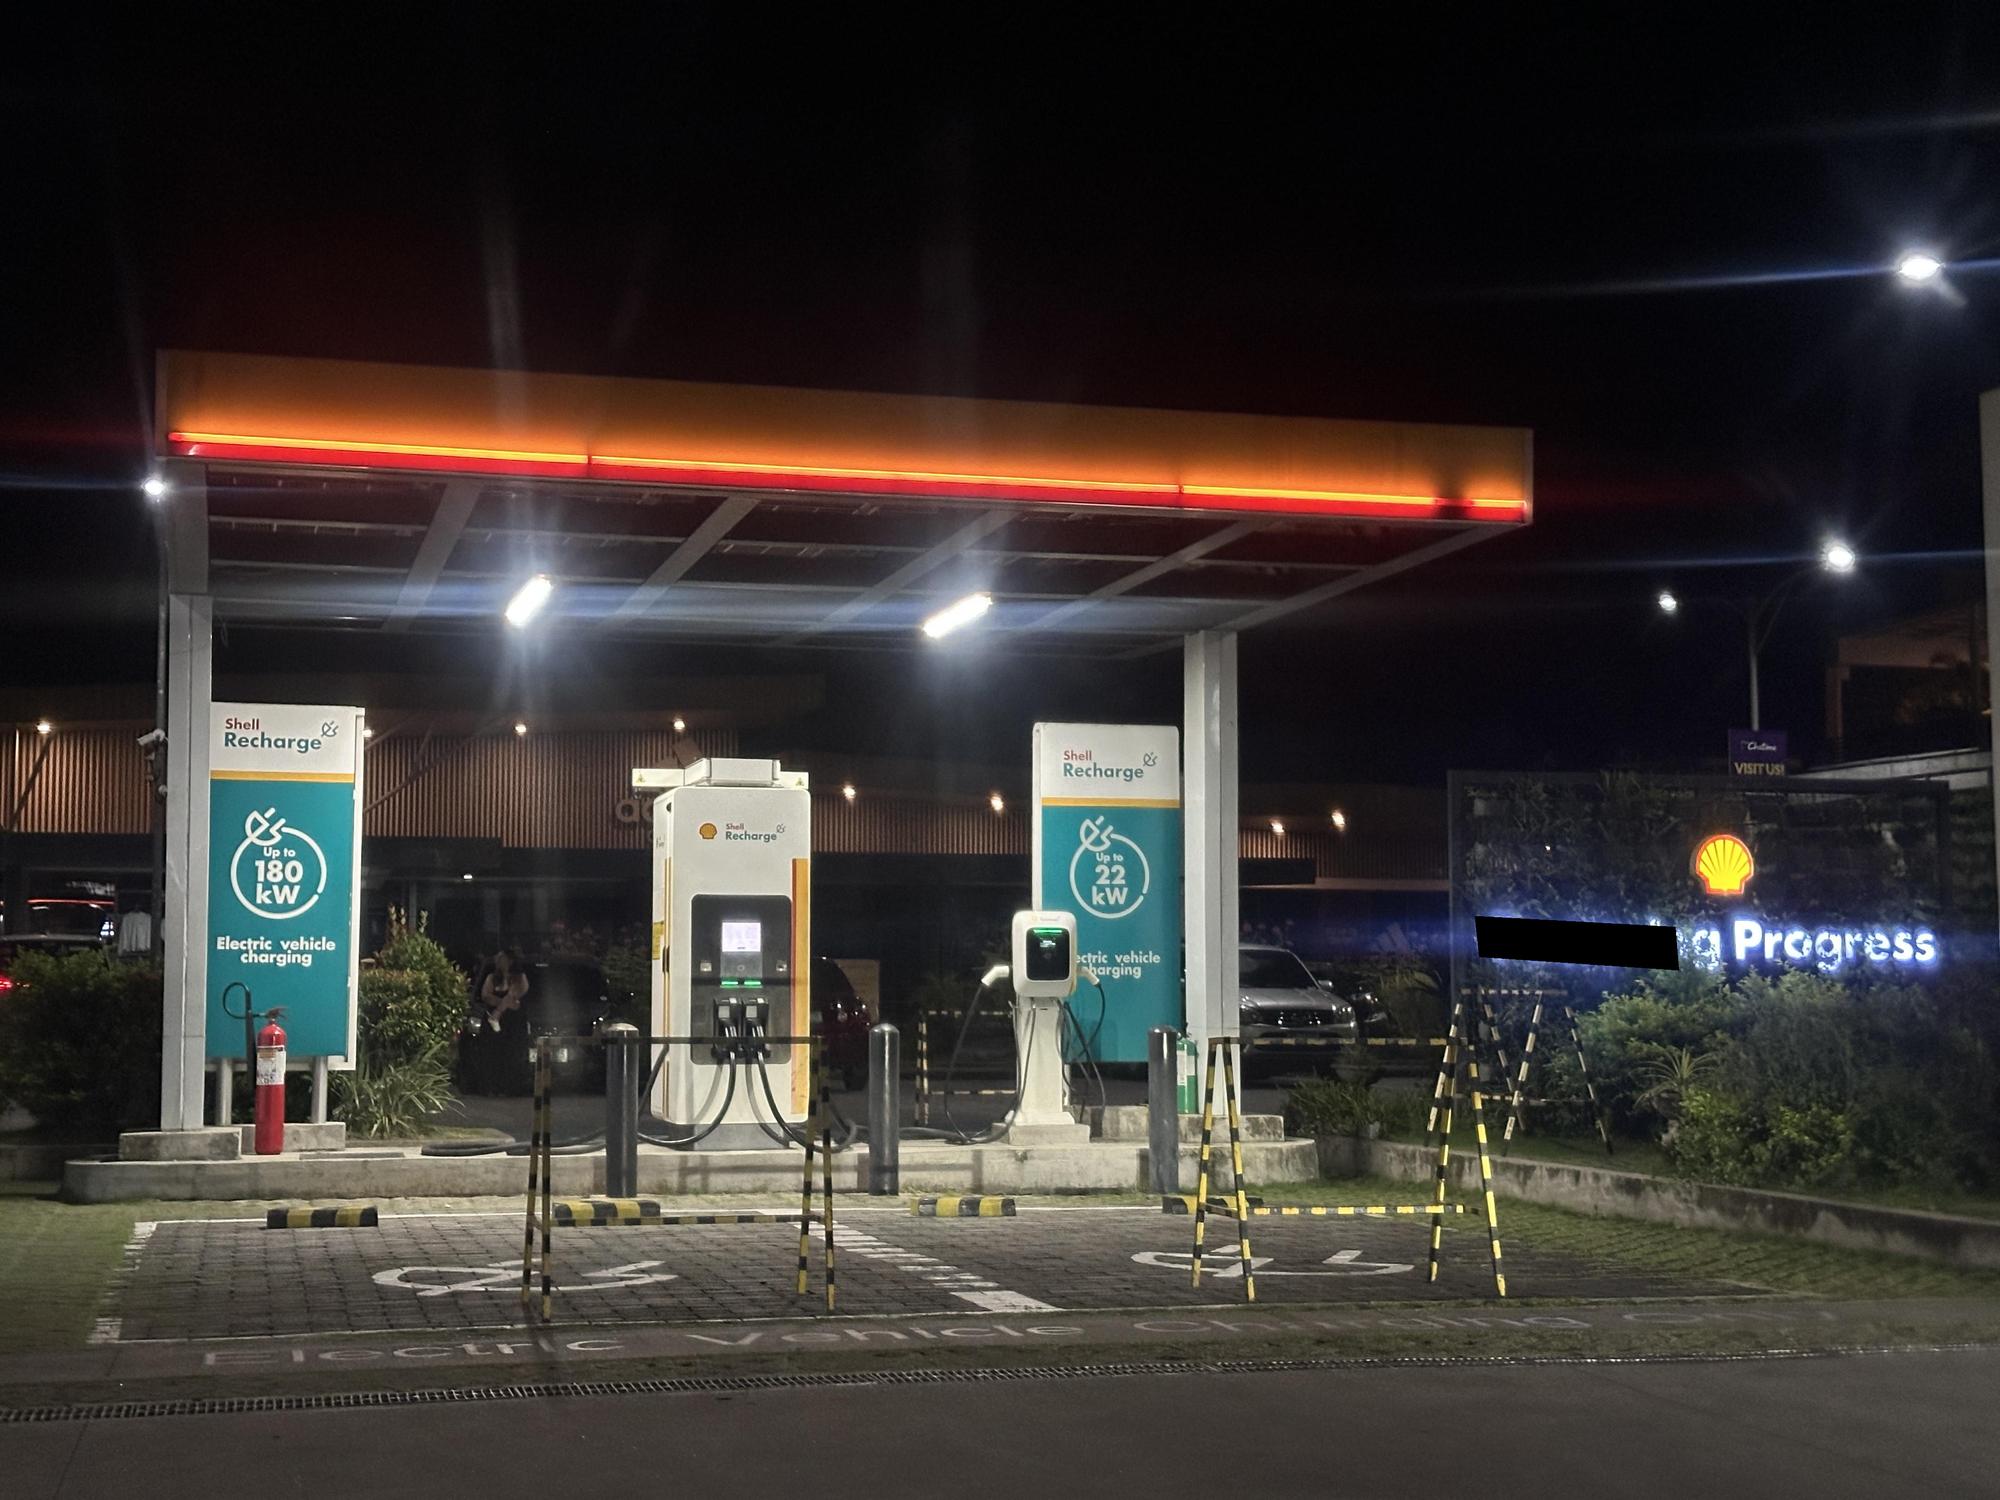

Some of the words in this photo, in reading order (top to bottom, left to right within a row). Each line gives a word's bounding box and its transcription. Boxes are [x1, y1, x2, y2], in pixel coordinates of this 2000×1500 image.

[224, 718, 260, 731] Shell
[224, 732, 322, 753] Recharge
[1063, 750, 1092, 761] Shell
[1063, 762, 1144, 782] Recharge
[1734, 762, 1765, 775] VISIT
[1766, 763, 1785, 776] US!
[725, 831, 777, 843] Recharge
[264, 846, 280, 859] Up
[284, 848, 296, 857] to
[1096, 852, 1110, 863] Up
[1113, 853, 1124, 862] to
[255, 860, 303, 883] 180
[1095, 865, 1126, 885] 22
[256, 883, 301, 904] kW
[1092, 885, 1129, 905] kW
[216, 936, 272, 950] Electric
[280, 936, 336, 951] vehicle
[1733, 919, 1936, 972] Progress
[240, 949, 313, 967] charging
[1076, 950, 1108, 964] ectric
[1115, 950, 1160, 964] vehicle
[1087, 962, 1142, 979] harging
[202, 1337, 625, 1366] Electric
[684, 1323, 1085, 1346] Vehicle
